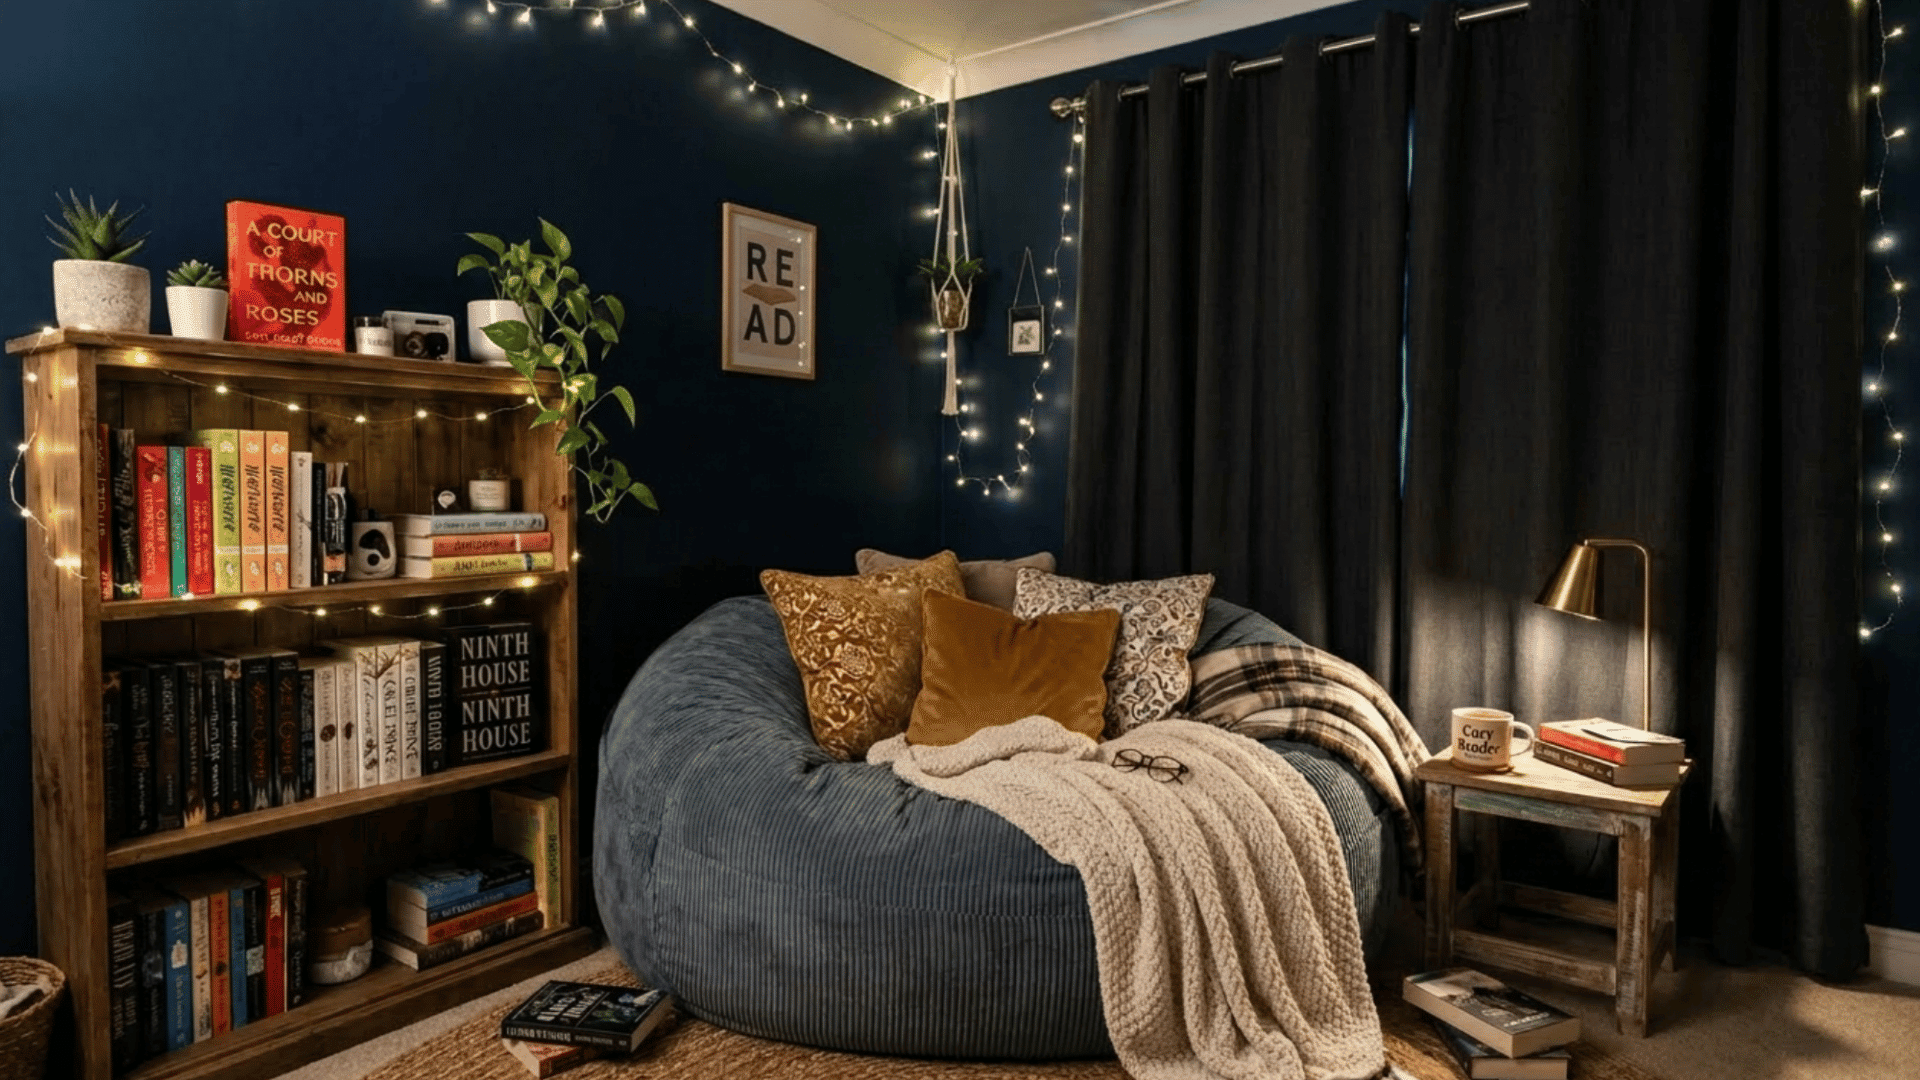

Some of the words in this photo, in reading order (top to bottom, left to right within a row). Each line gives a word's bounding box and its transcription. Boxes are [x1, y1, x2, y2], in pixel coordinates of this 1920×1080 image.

[246, 220, 260, 236] A
[267, 222, 338, 247] COURT
[293, 291, 327, 305] AND
[245, 304, 319, 326] ROSES
[461, 632, 529, 660] NINTH
[461, 660, 530, 689] HOUSE
[462, 693, 531, 725] NINTH
[462, 722, 531, 753] HOUSE
